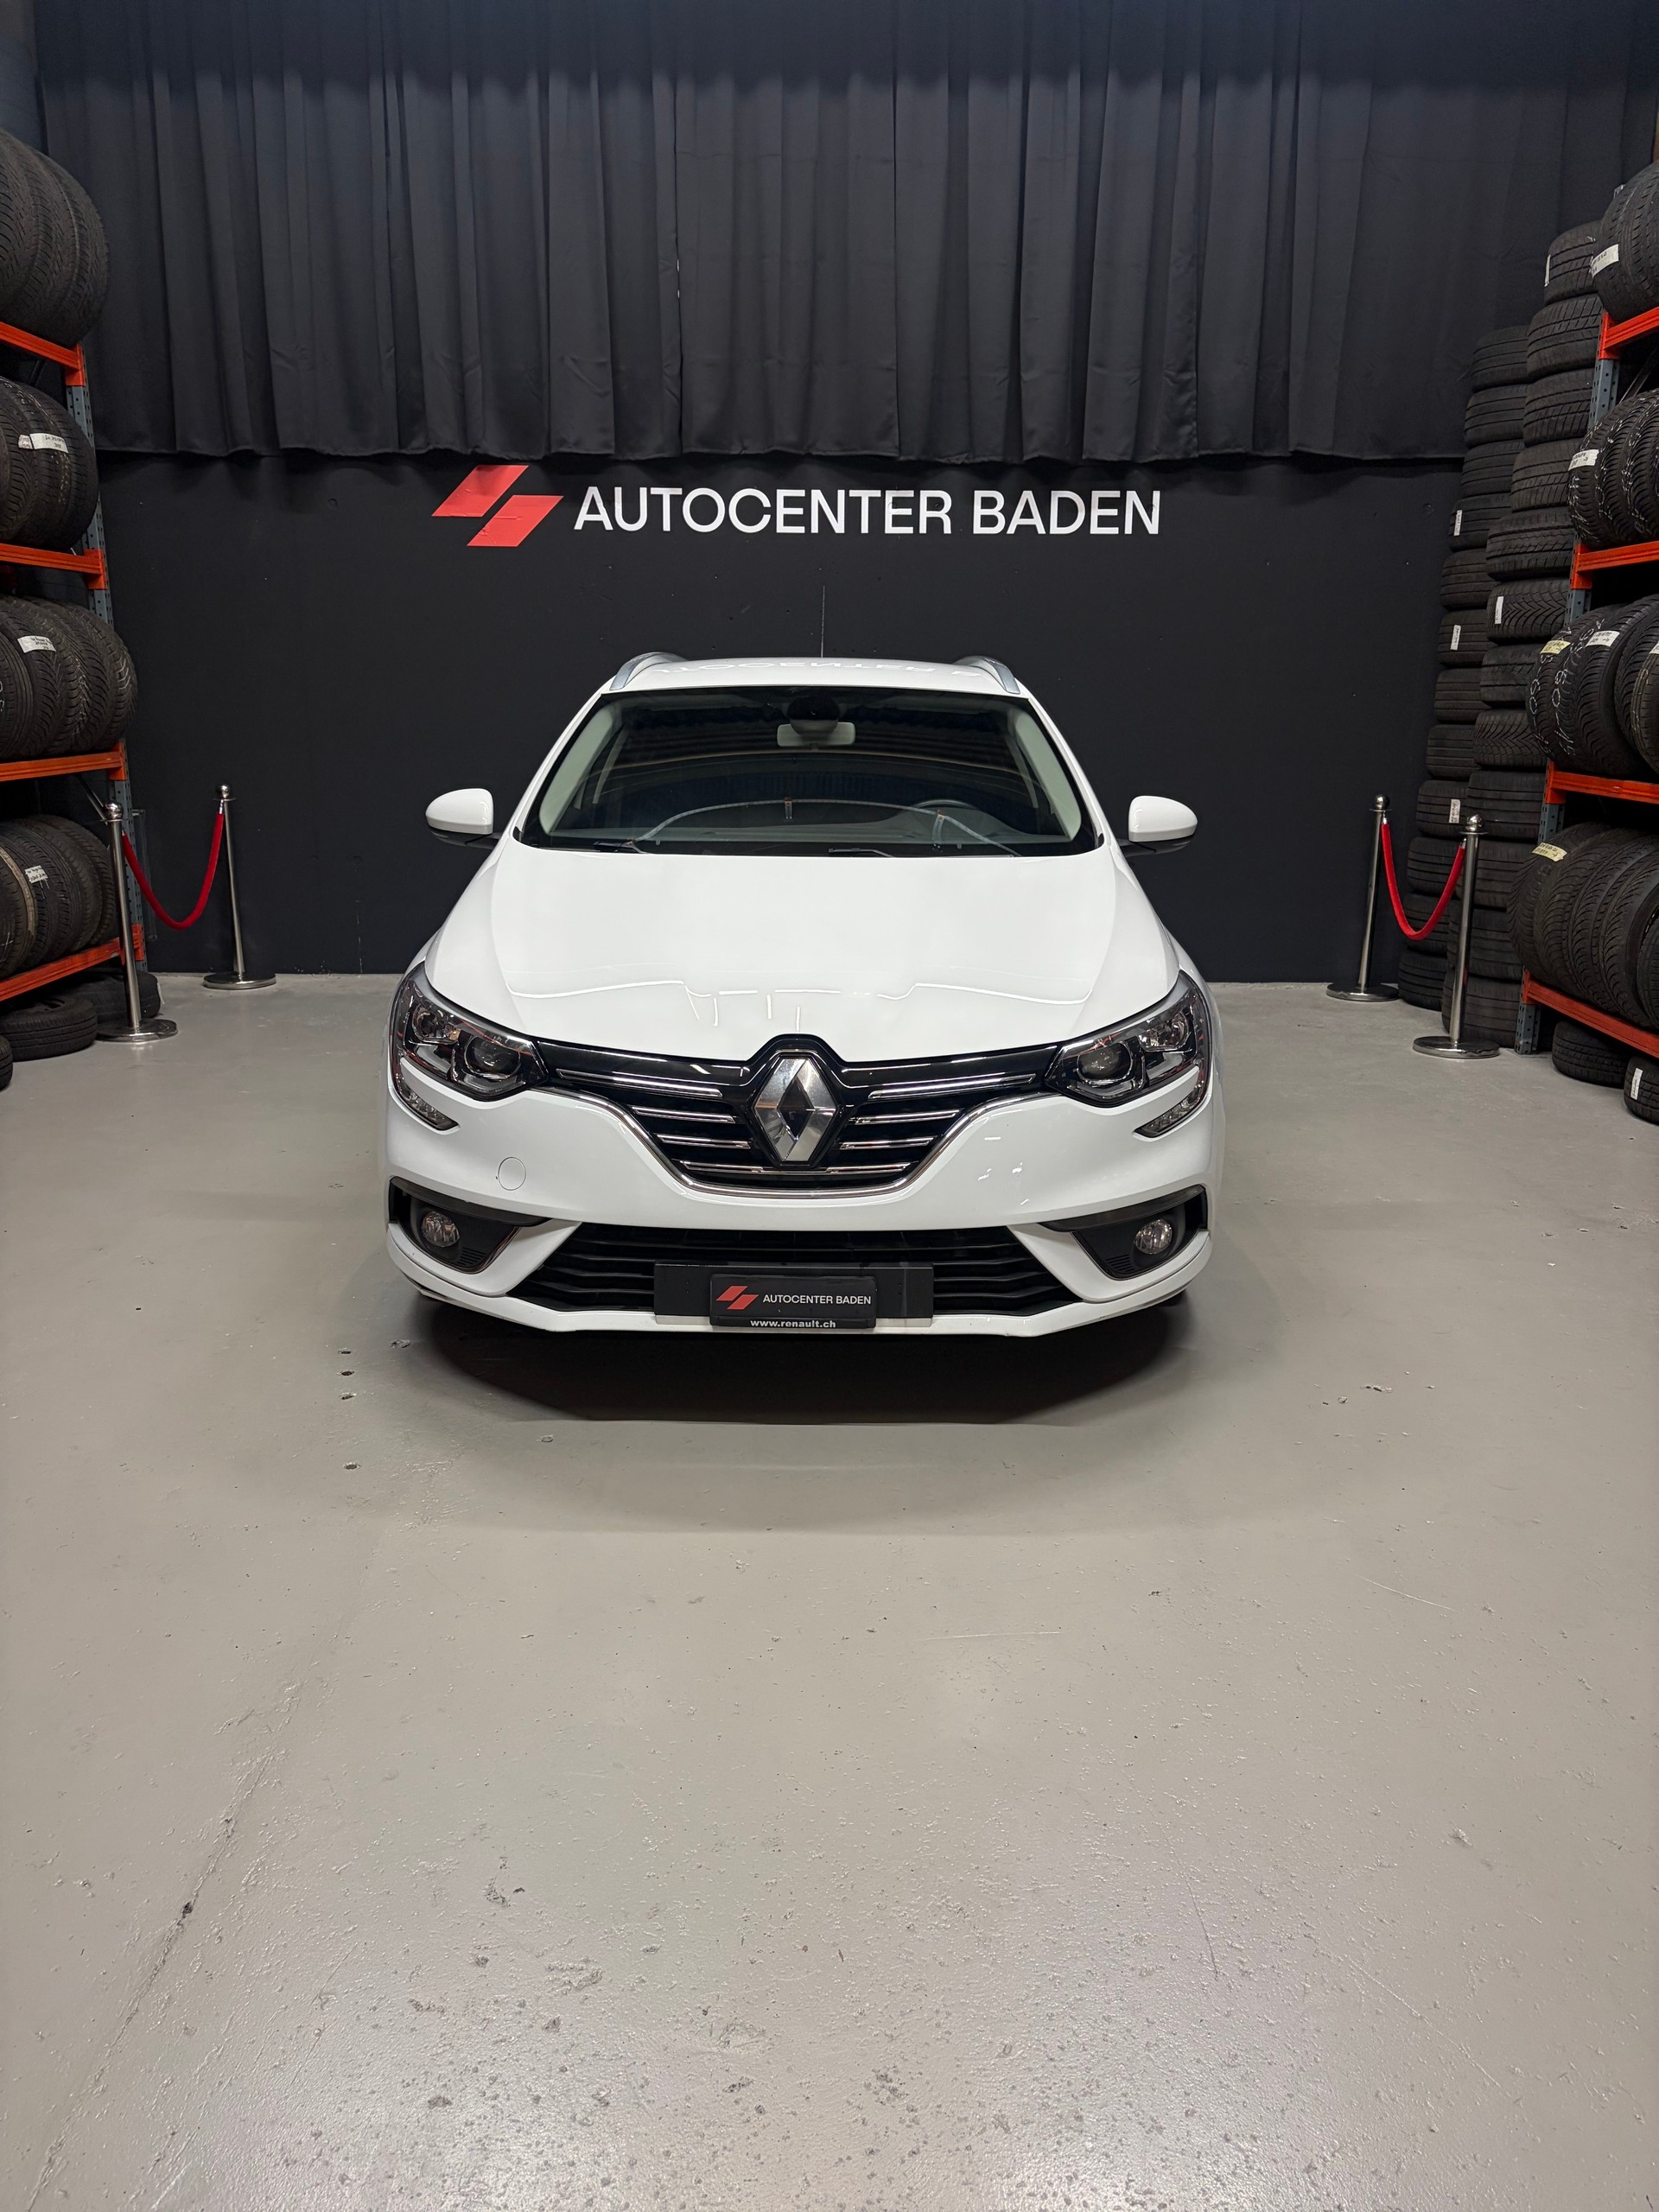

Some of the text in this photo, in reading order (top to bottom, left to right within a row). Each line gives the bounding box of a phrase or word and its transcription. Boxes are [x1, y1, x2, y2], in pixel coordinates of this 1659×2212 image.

[574, 486, 1160, 535] AUTOCENTER BADEN
[763, 1294, 872, 1305] AUTOCENTER BADEN
[750, 1319, 836, 1328] www.renault.ch
